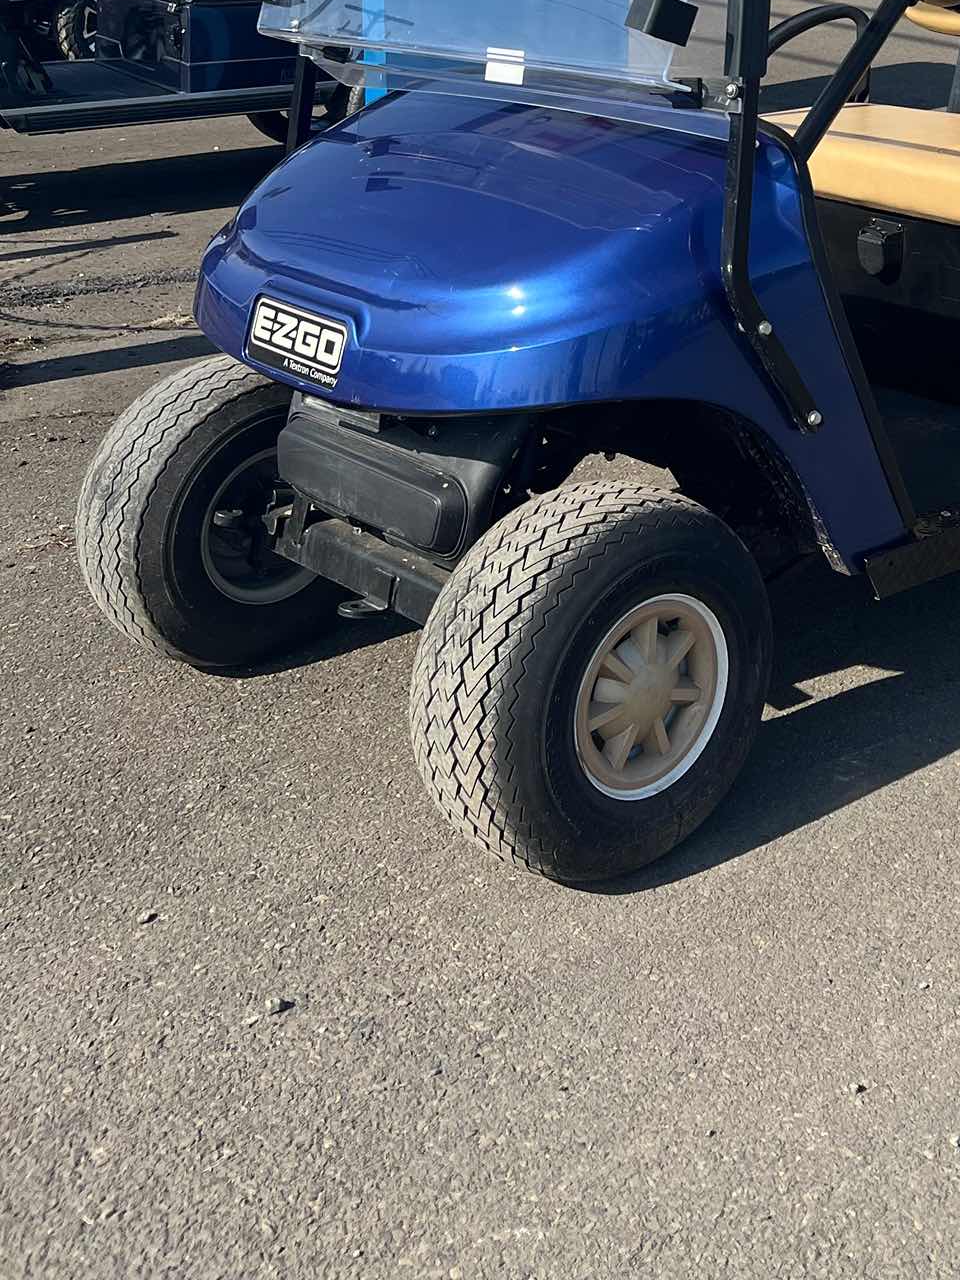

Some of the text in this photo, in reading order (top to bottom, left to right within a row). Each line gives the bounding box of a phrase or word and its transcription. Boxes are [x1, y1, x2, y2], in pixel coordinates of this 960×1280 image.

[282, 358, 338, 388] A Textron Company
